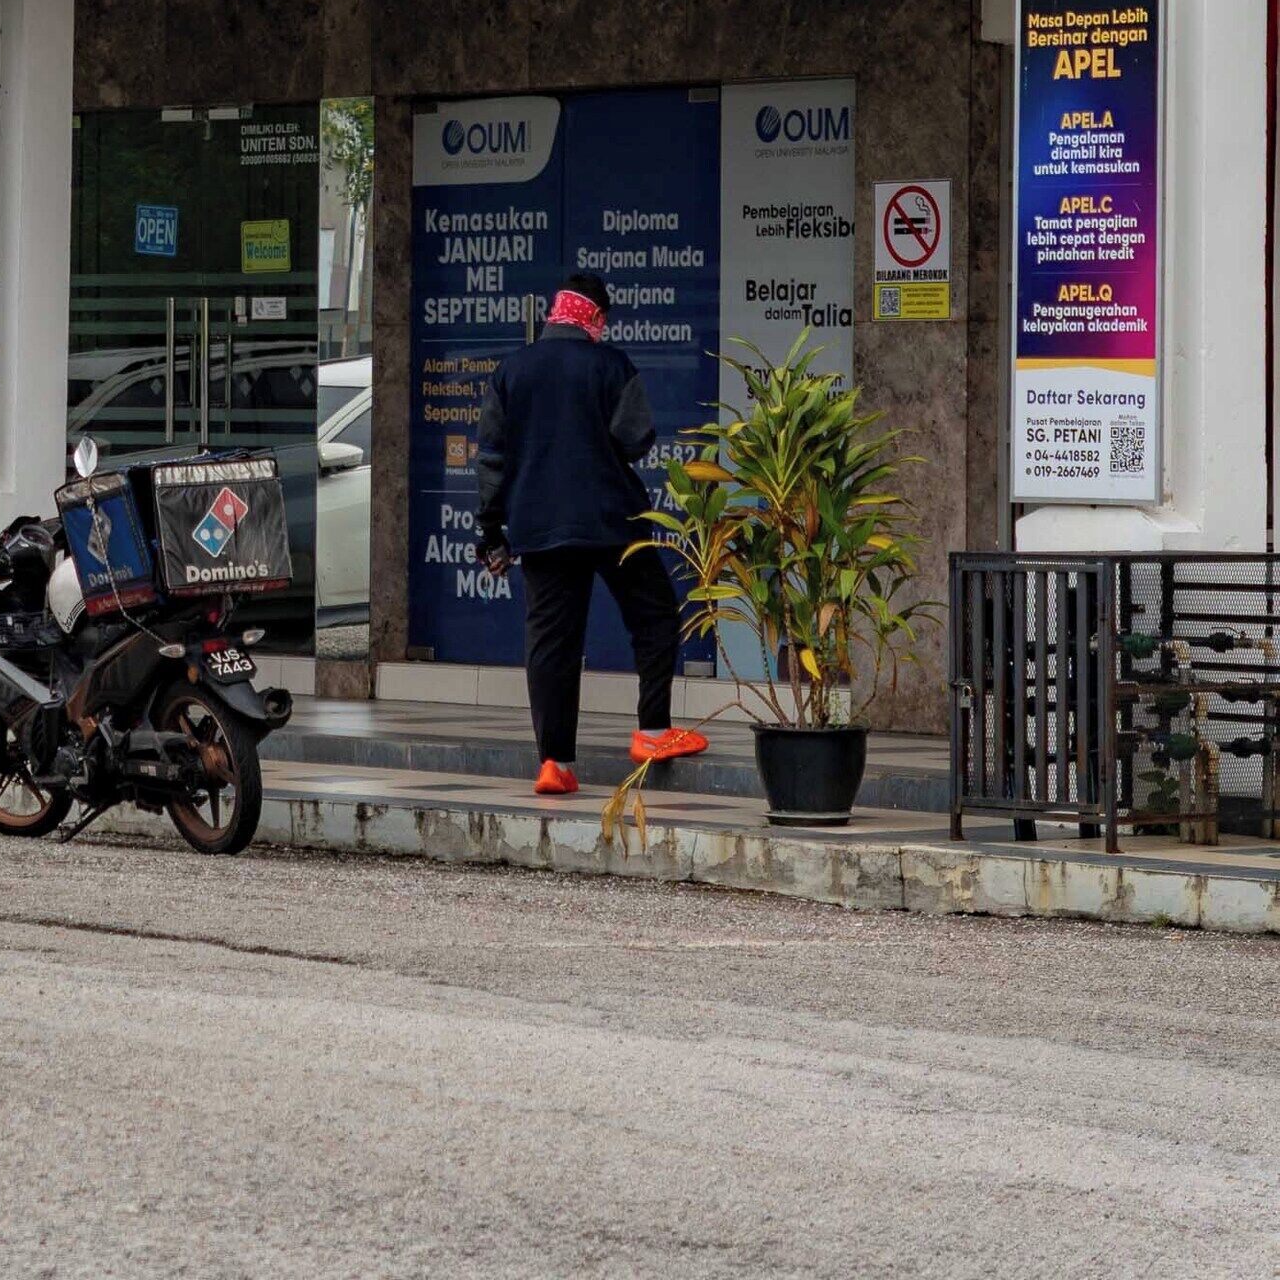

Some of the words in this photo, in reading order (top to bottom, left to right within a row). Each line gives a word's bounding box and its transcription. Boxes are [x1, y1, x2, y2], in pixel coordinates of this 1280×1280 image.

[1028, 14, 1063, 28] Masa
[1066, 12, 1109, 32] Depan
[1112, 7, 1148, 24] Lebih
[1028, 30, 1088, 48] Bersinar
[1089, 28, 1148, 49] dengan
[1053, 48, 1121, 80] APEL
[784, 107, 849, 142] OUM
[1061, 111, 1114, 129] APEL.A
[241, 137, 286, 152] UNITEM
[288, 136, 317, 150] SDN.
[467, 121, 525, 154] OUM
[1049, 131, 1125, 148] Pengalaman
[1051, 146, 1096, 160] diambil
[1099, 145, 1122, 159] kira
[1034, 162, 1068, 175] untuk
[1071, 160, 1140, 175] kemasukan
[742, 203, 834, 222] Pembelajaran
[1060, 197, 1113, 214] APEL.C
[425, 206, 548, 233] Kemasukan
[602, 209, 679, 235] Diploma
[1035, 215, 1072, 230] Tamat
[1075, 214, 1137, 232] pengajian
[138, 218, 174, 245] OPEN
[756, 224, 785, 237] Lebih
[1027, 231, 1057, 246] lebih
[1060, 233, 1095, 248] cepat
[1098, 231, 1145, 247] dengan
[246, 241, 288, 259] Welcome
[437, 235, 534, 265] JANUARI
[577, 247, 647, 273] Sarjana
[652, 245, 704, 268] Muda
[1037, 247, 1095, 265] pindahan
[1098, 246, 1135, 261] kredit
[466, 266, 504, 293] MEI
[876, 270, 912, 281] DILARANG
[912, 269, 948, 280] MEROKOK
[605, 282, 675, 309] Sarjana
[746, 280, 817, 306] Belajar
[1058, 284, 1113, 302] APEL.Q
[765, 307, 802, 321] dalam
[1033, 303, 1137, 320] Penganugerahan
[602, 319, 692, 343] edoktoran
[1023, 318, 1085, 335] kelayakan
[1087, 318, 1148, 333] akademik
[423, 358, 459, 373] Alami
[422, 381, 477, 398] Fleksibel,
[1026, 389, 1073, 405] Daftar
[1076, 390, 1146, 409] Sekarang
[424, 404, 482, 426] Sepanja
[1026, 417, 1048, 426] Pusat
[1049, 417, 1102, 428] Pembelajaran
[1027, 428, 1049, 443] SG.
[1054, 428, 1102, 443] PETANI
[1034, 449, 1100, 462] 04-4418582
[1034, 465, 1100, 478] 019-2667469
[186, 560, 269, 583] Domino's
[457, 569, 512, 600] MQA
[210, 649, 241, 663] VJS
[211, 659, 253, 676] 7443
